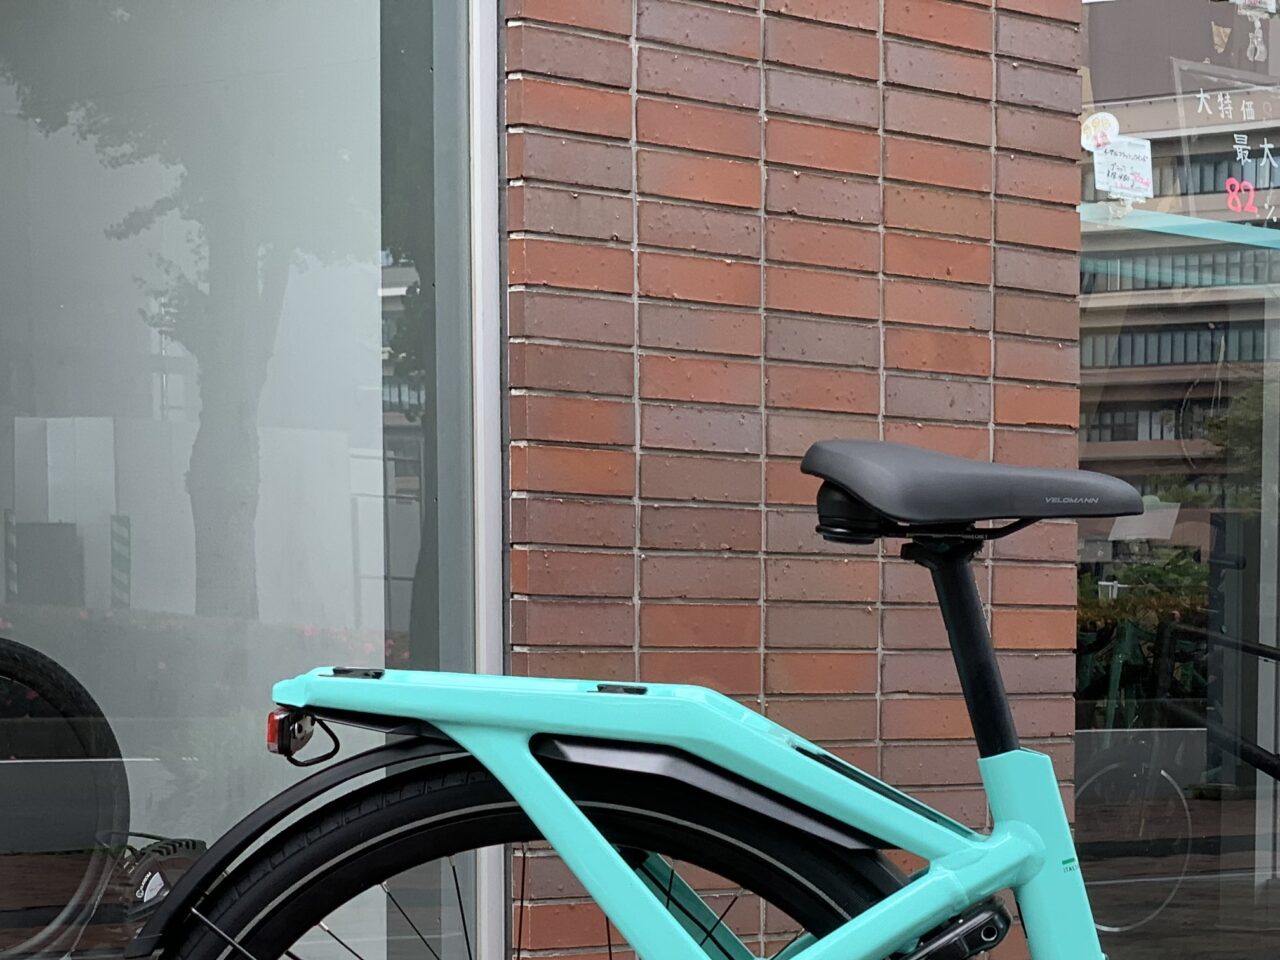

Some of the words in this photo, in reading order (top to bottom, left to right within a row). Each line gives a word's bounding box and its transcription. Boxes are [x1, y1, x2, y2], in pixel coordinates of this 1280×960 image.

[1195, 87, 1255, 120] 大特価
[1232, 133, 1279, 168] 最大
[1044, 496, 1100, 504] VELOMANN
